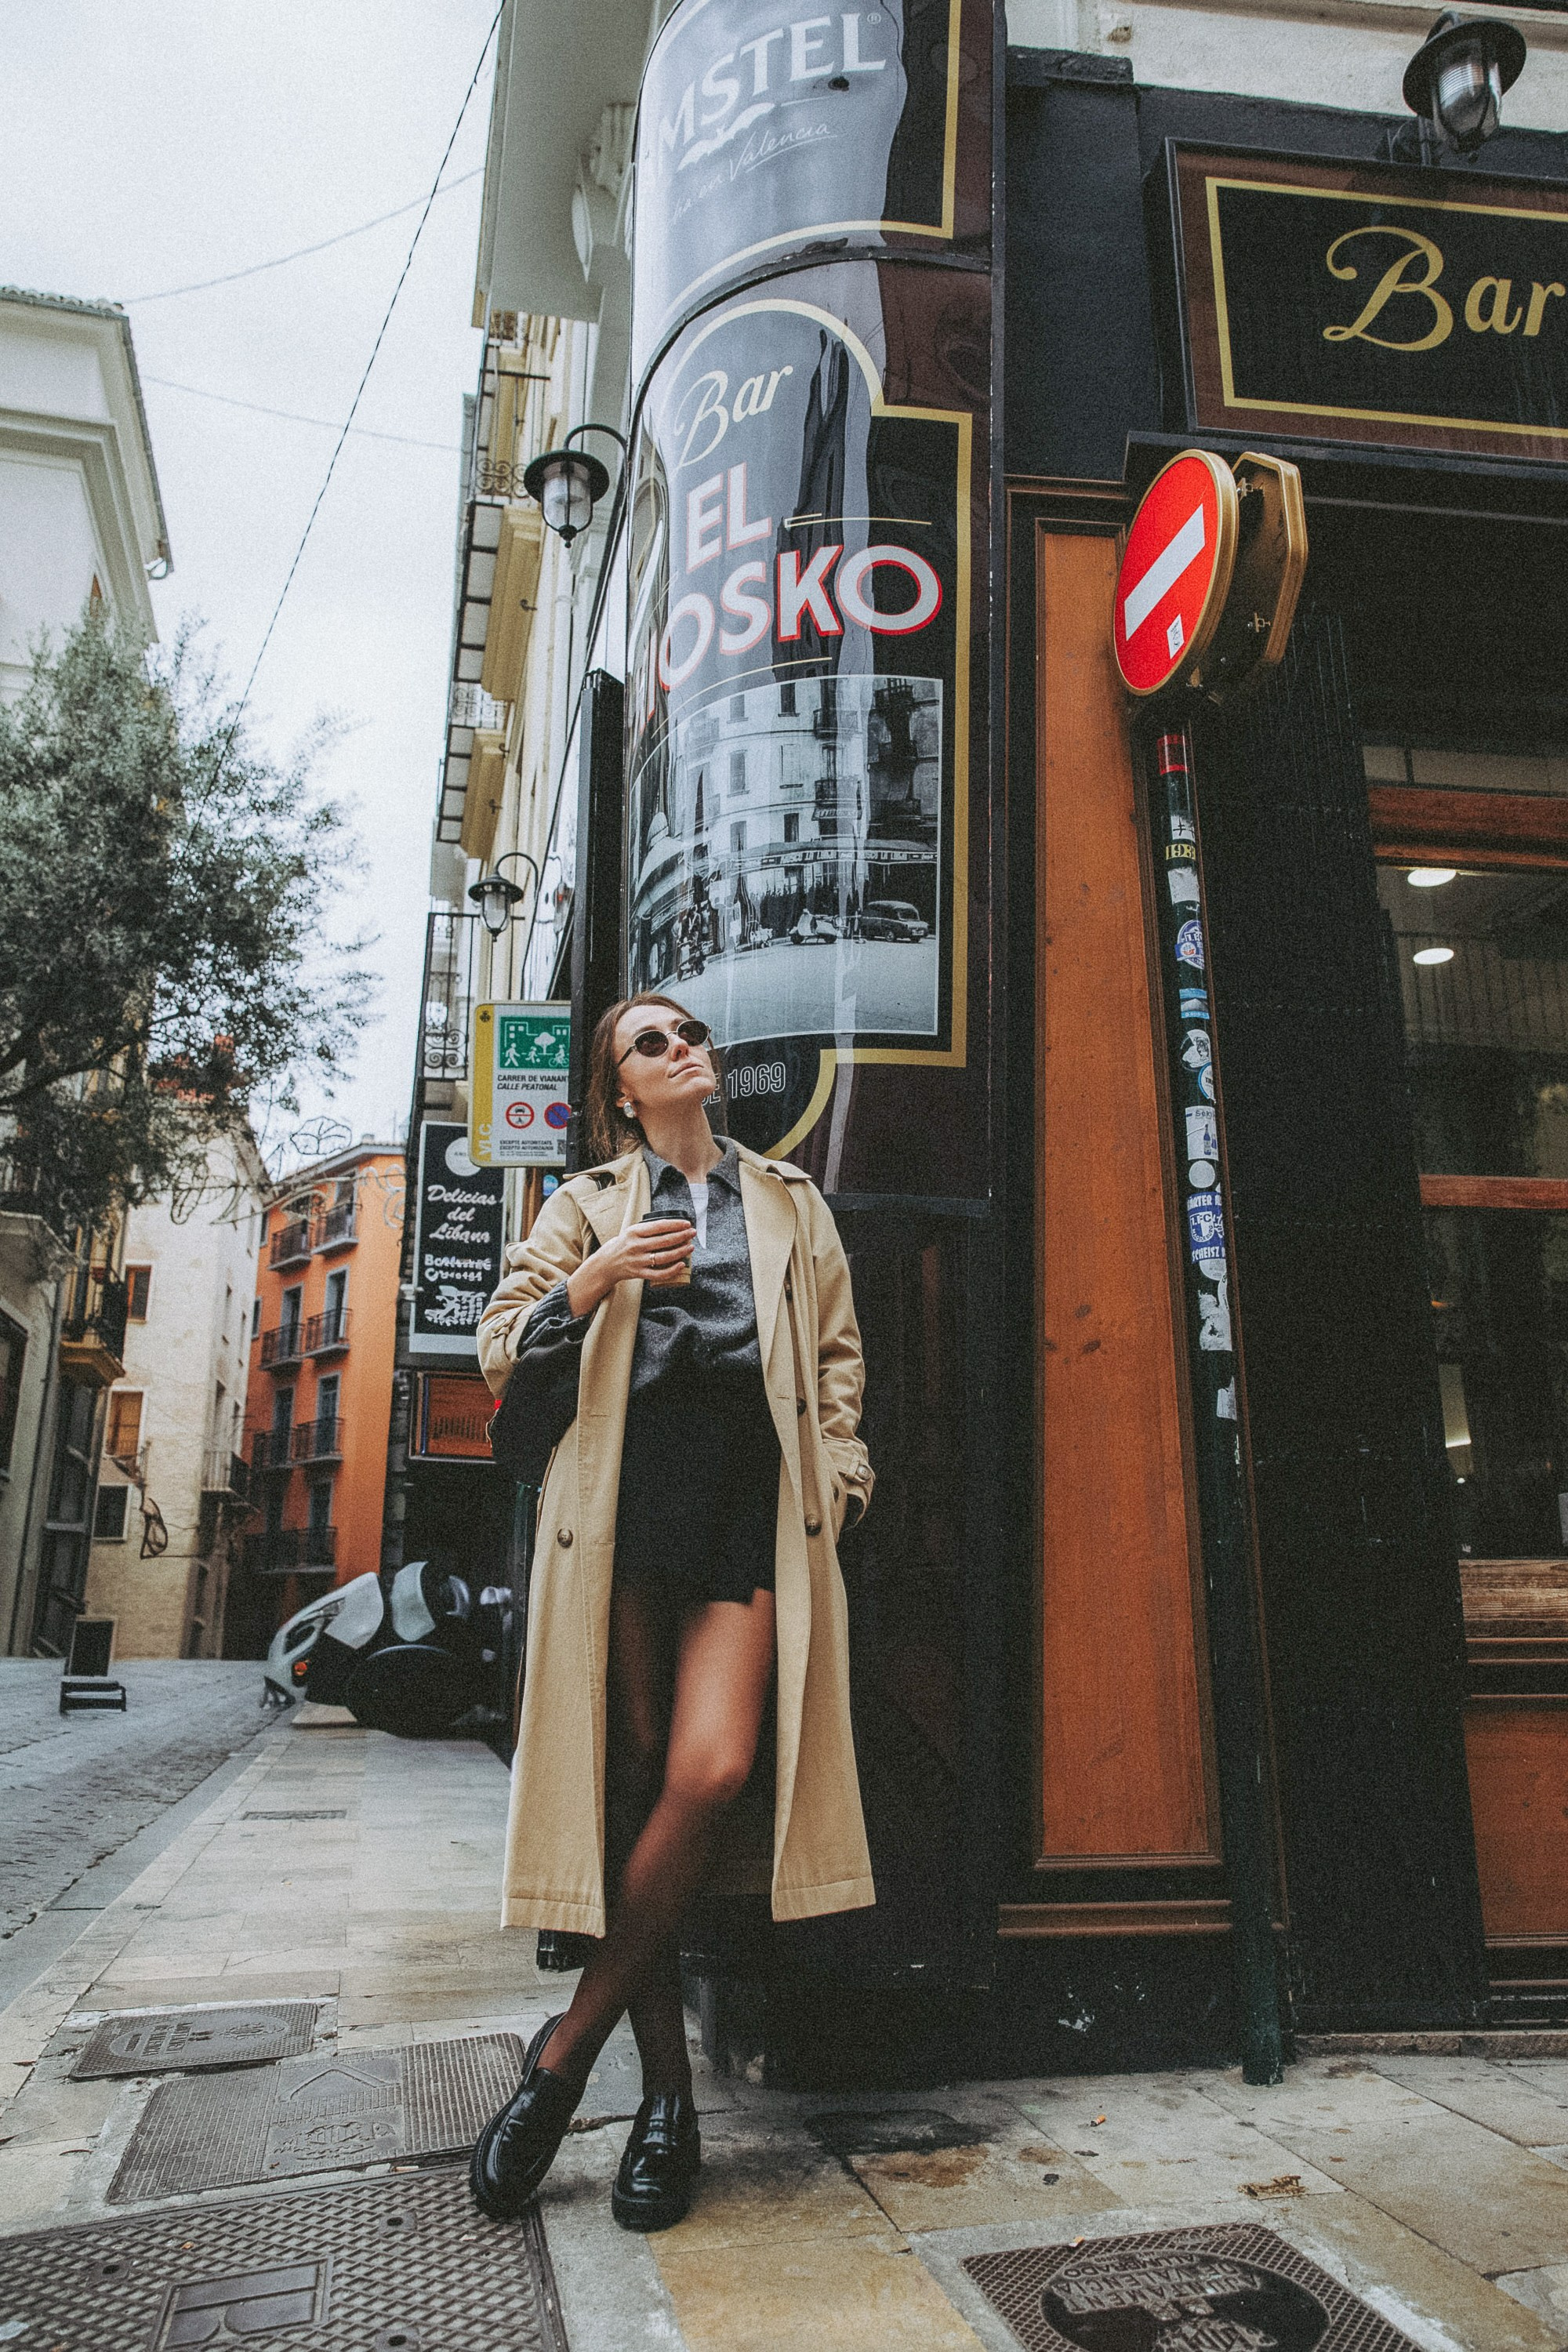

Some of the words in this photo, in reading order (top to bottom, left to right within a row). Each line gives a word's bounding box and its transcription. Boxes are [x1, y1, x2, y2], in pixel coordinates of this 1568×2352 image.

[657, 13, 886, 154] MSTEL
[729, 124, 831, 182] Valencia
[1323, 225, 1566, 352] Bar
[673, 365, 793, 468] Bar
[685, 463, 771, 574] EL
[728, 1062, 786, 1099] 1969
[427, 1184, 497, 1205] Delicias
[447, 1207, 476, 1221] del
[1192, 1246, 1220, 1261] SCHEISZ
[1058, 2268, 1187, 2295] VALENCIA
[1063, 2254, 1195, 2279] ALUMBRADO
[1069, 2274, 1261, 2312] AJUNTAMENT
